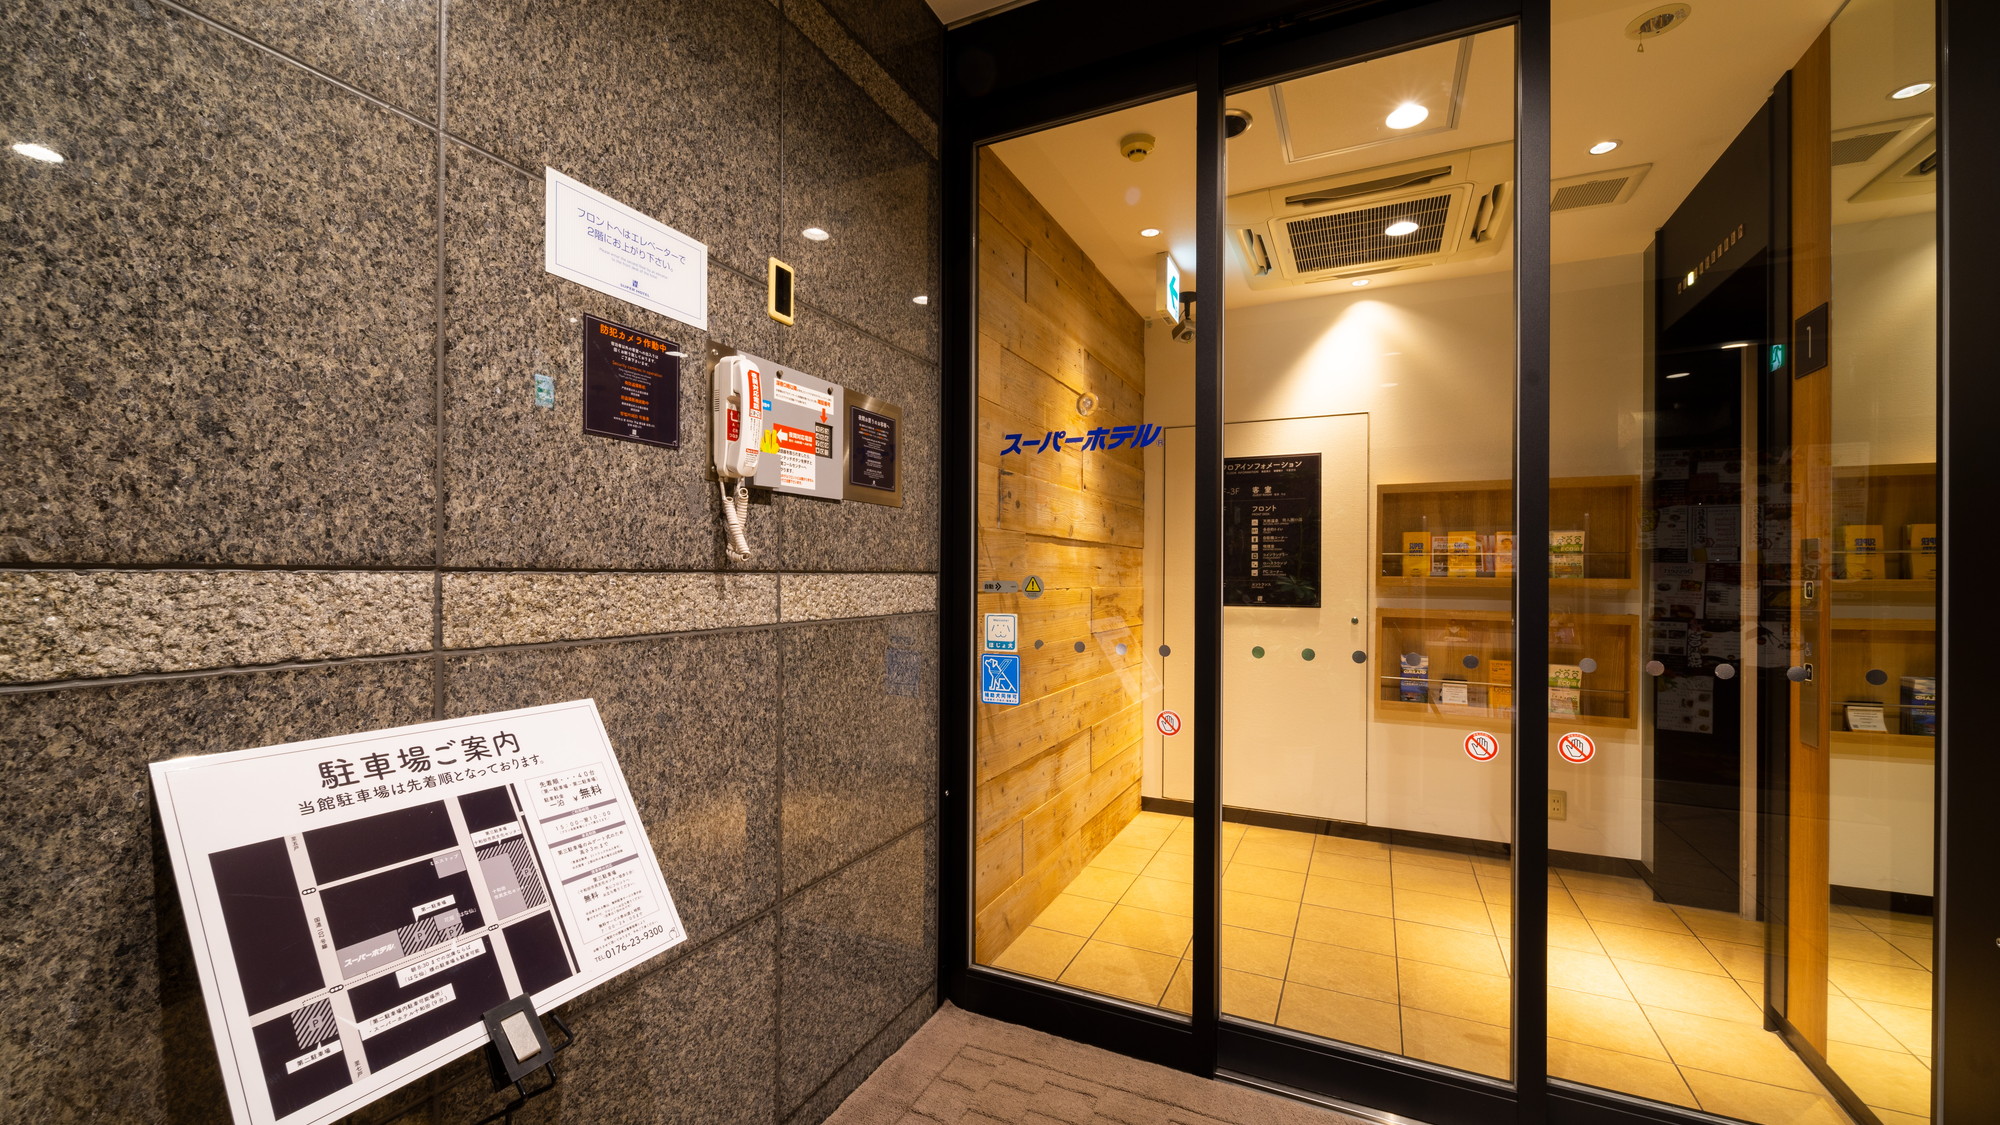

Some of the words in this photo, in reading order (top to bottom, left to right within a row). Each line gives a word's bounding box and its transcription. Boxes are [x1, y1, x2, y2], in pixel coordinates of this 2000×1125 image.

[578, 208, 686, 265] フロントへはエレベーターで
[588, 226, 673, 272] 2階にお上がり下さい。
[621, 283, 635, 291] SUPER
[636, 289, 650, 297] HOTEL
[600, 324, 666, 352] 防犯カメラ作動中
[1000, 424, 1162, 456] スーパーホテル
[318, 730, 521, 790] 駐車場ご案内
[299, 754, 544, 816] 当館駐車場は先着順となっております。
[579, 784, 602, 799] 無料
[421, 900, 446, 912] 第一駐車場
[584, 892, 599, 903] 無料
[605, 925, 664, 959] 0176-23-9300
[344, 944, 394, 968] スーパーホテル
[313, 1020, 318, 1028] P
[297, 1048, 330, 1067] 第二駐車場
